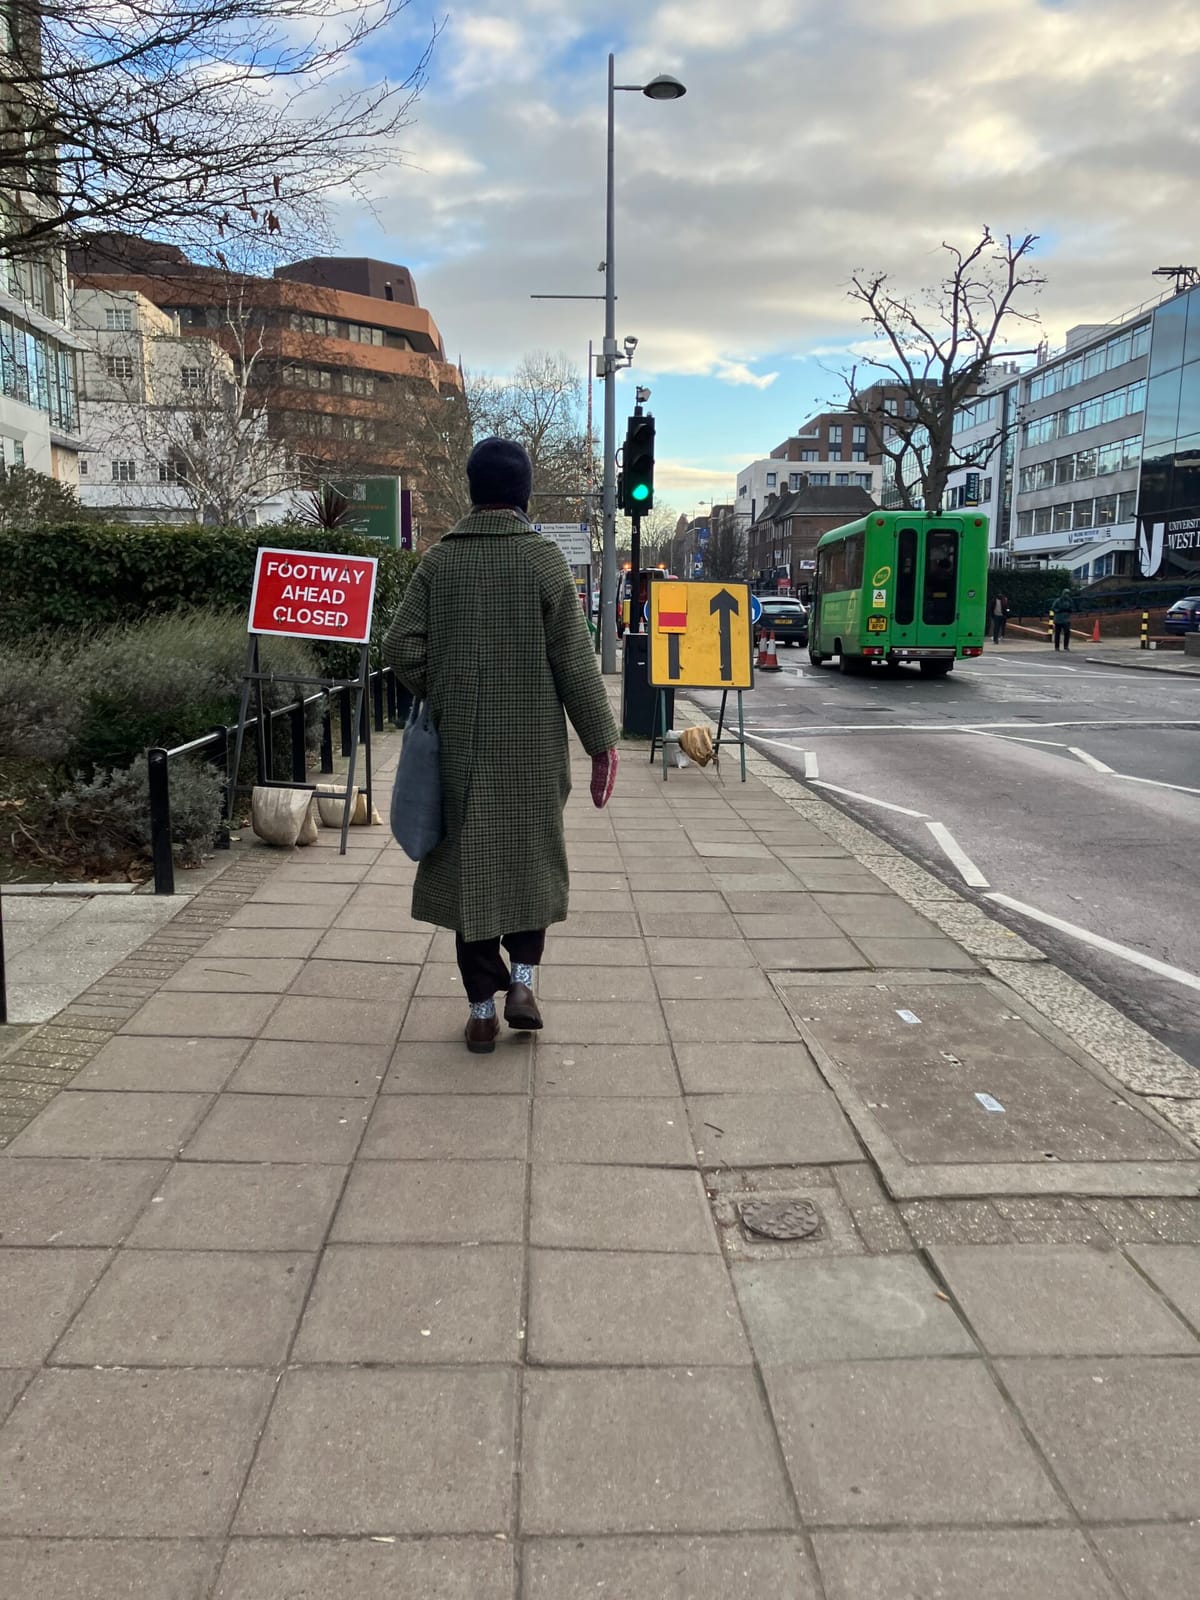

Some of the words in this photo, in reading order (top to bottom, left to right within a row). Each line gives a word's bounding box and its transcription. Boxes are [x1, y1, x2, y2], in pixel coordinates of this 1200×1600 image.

[1168, 532, 1195, 550] WEST
[267, 562, 365, 585] FOOTWAY
[281, 585, 345, 605] AHEAD
[273, 606, 348, 628] CLOSED
